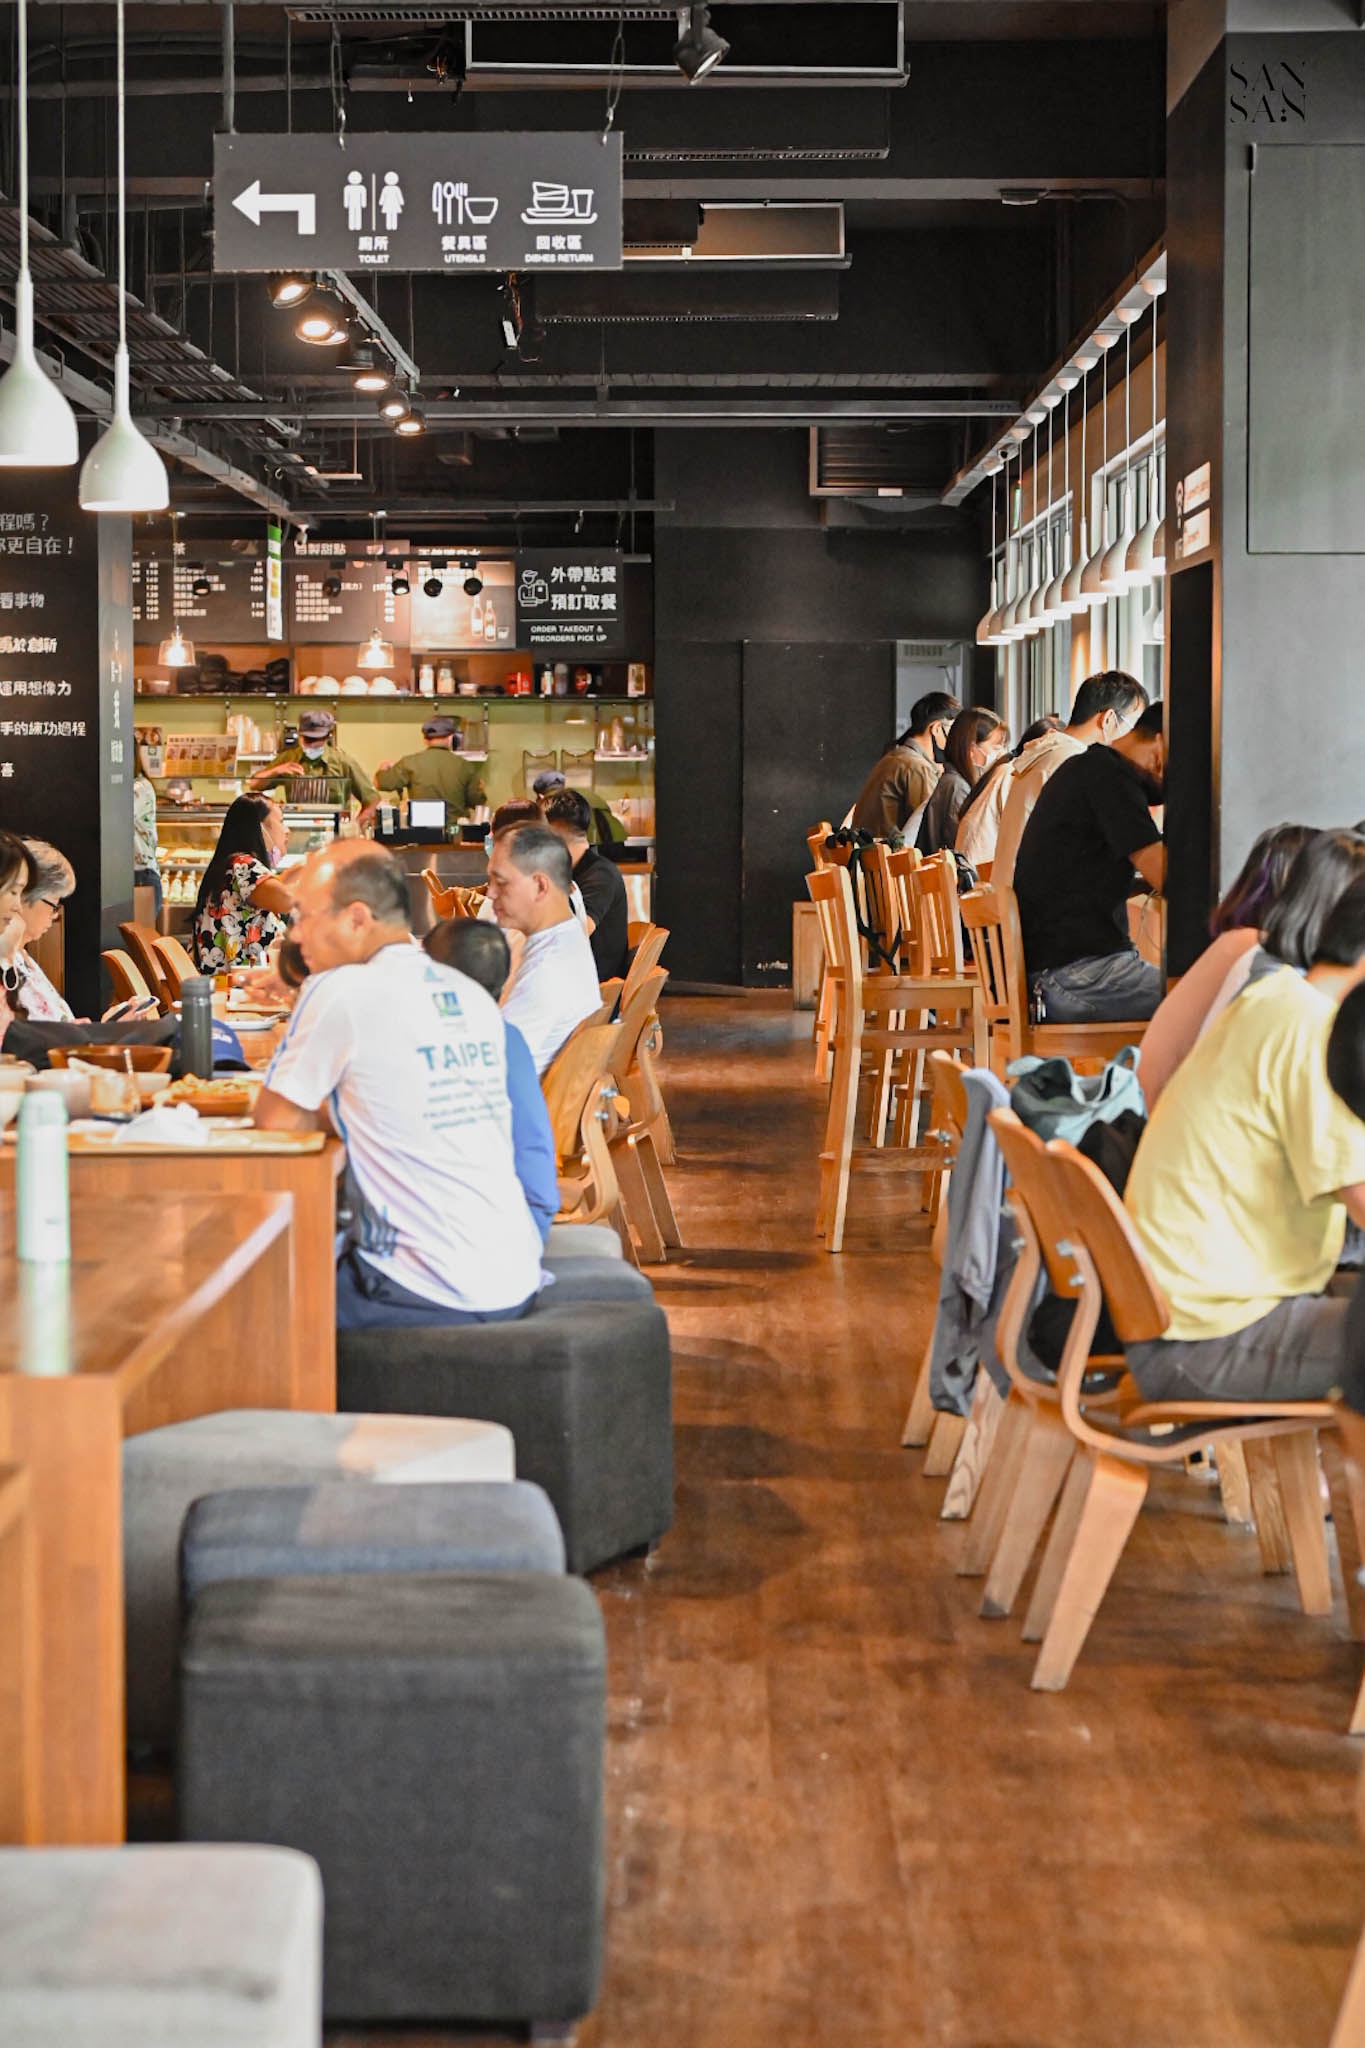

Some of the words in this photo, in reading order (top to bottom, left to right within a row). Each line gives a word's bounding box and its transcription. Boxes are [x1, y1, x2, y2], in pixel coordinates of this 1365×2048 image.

[358, 235, 389, 251] 廁所
[441, 235, 487, 251] 餐具區
[536, 234, 582, 250] 回收區
[358, 254, 390, 263] TOILET
[444, 254, 486, 263] UTENSILS
[525, 253, 556, 263] DISHES
[557, 253, 594, 263] RETURN
[551, 566, 616, 583] 外帶點餐
[551, 594, 616, 610] 預訂取餐
[530, 625, 557, 633] ORDER
[558, 625, 594, 633] TAKEOUT
[596, 625, 604, 633] &
[530, 634, 576, 642] PREORDERS
[577, 634, 594, 642] PICK
[596, 634, 607, 642] UP
[0, 680, 72, 696] 運用想像力
[0, 721, 87, 737] 手的練功過程
